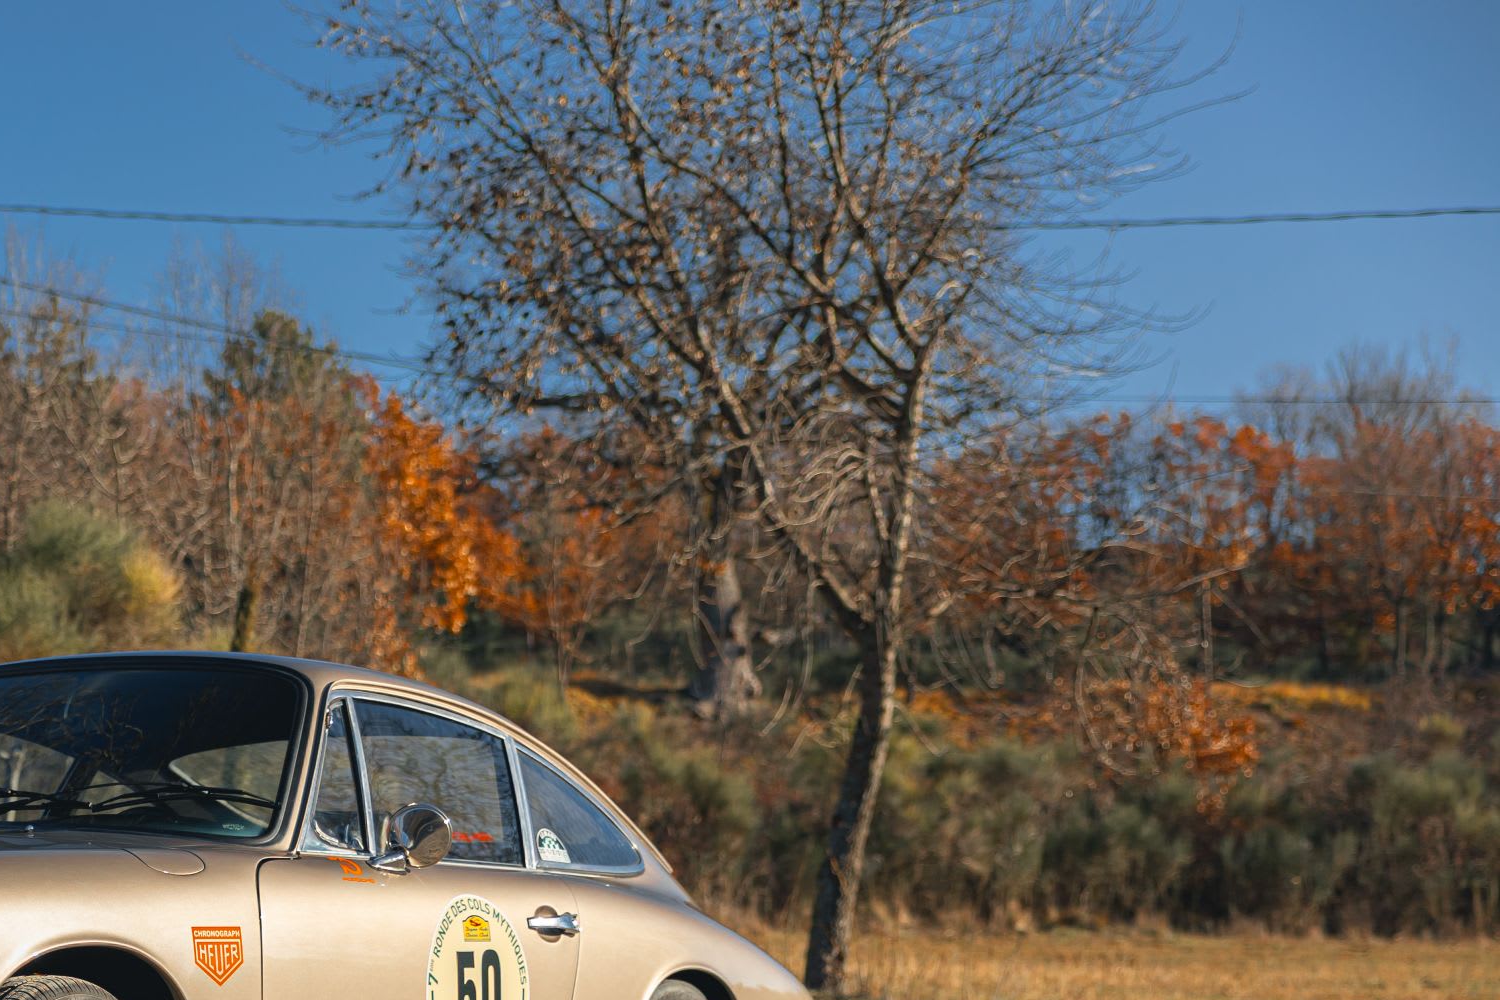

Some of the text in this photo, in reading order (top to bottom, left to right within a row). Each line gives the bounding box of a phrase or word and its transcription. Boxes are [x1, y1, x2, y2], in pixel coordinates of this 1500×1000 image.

[193, 929, 240, 938] CHRONOGRAPH
[433, 911, 453, 958] RONDE
[450, 899, 467, 918] DES
[467, 898, 490, 915] COLS
[492, 908, 527, 985] MYTHIQUES
[199, 944, 239, 976] HEUER
